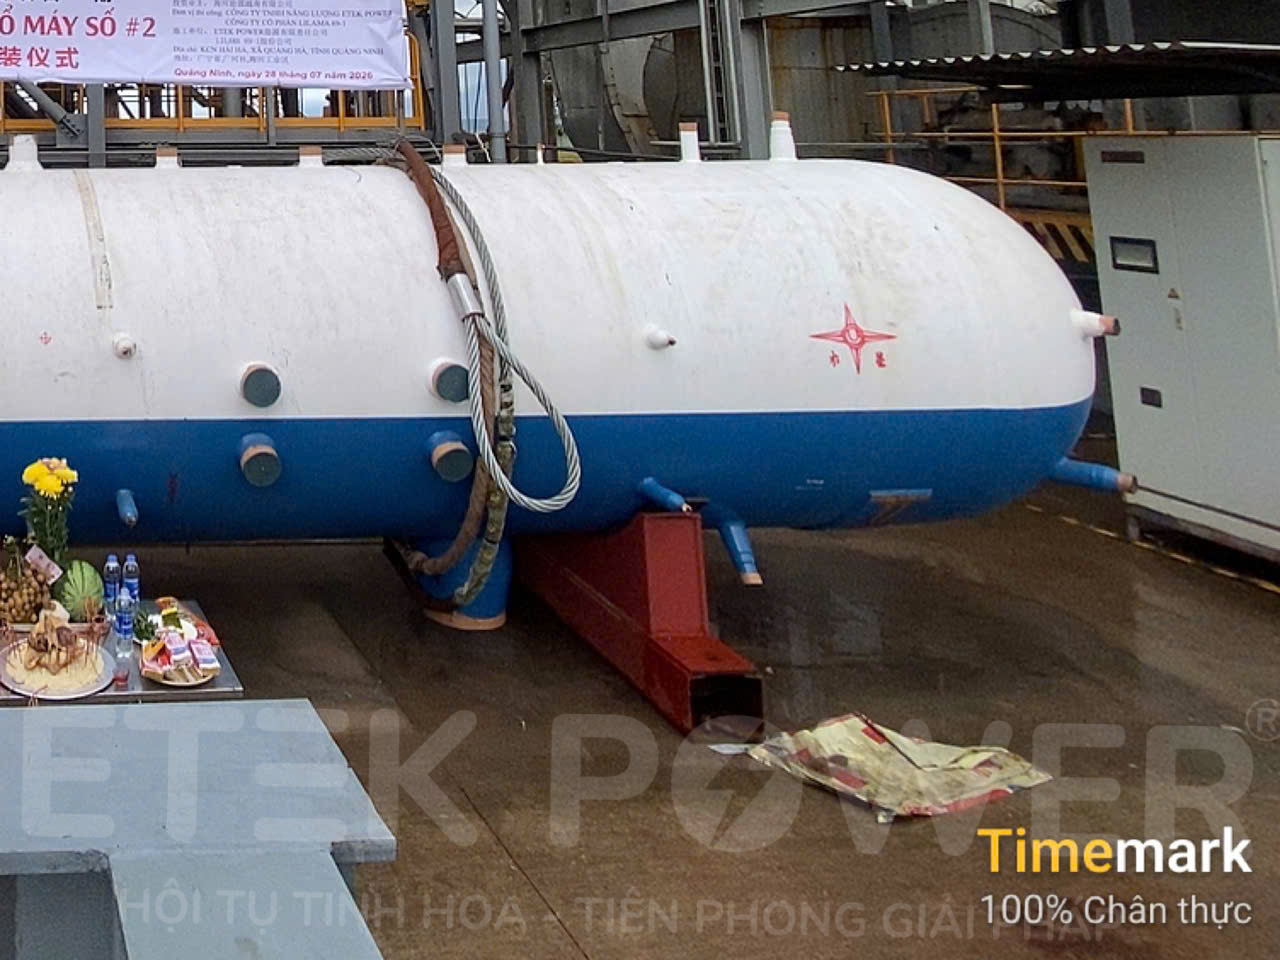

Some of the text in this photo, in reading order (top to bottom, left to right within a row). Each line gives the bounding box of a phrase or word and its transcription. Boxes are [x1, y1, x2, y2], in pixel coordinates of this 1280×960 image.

[250, 9, 260, 17] TY
[24, 8, 79, 36] MÁY
[86, 4, 117, 37] SỐ
[126, 16, 156, 37] #2
[310, 71, 322, 79] 07
